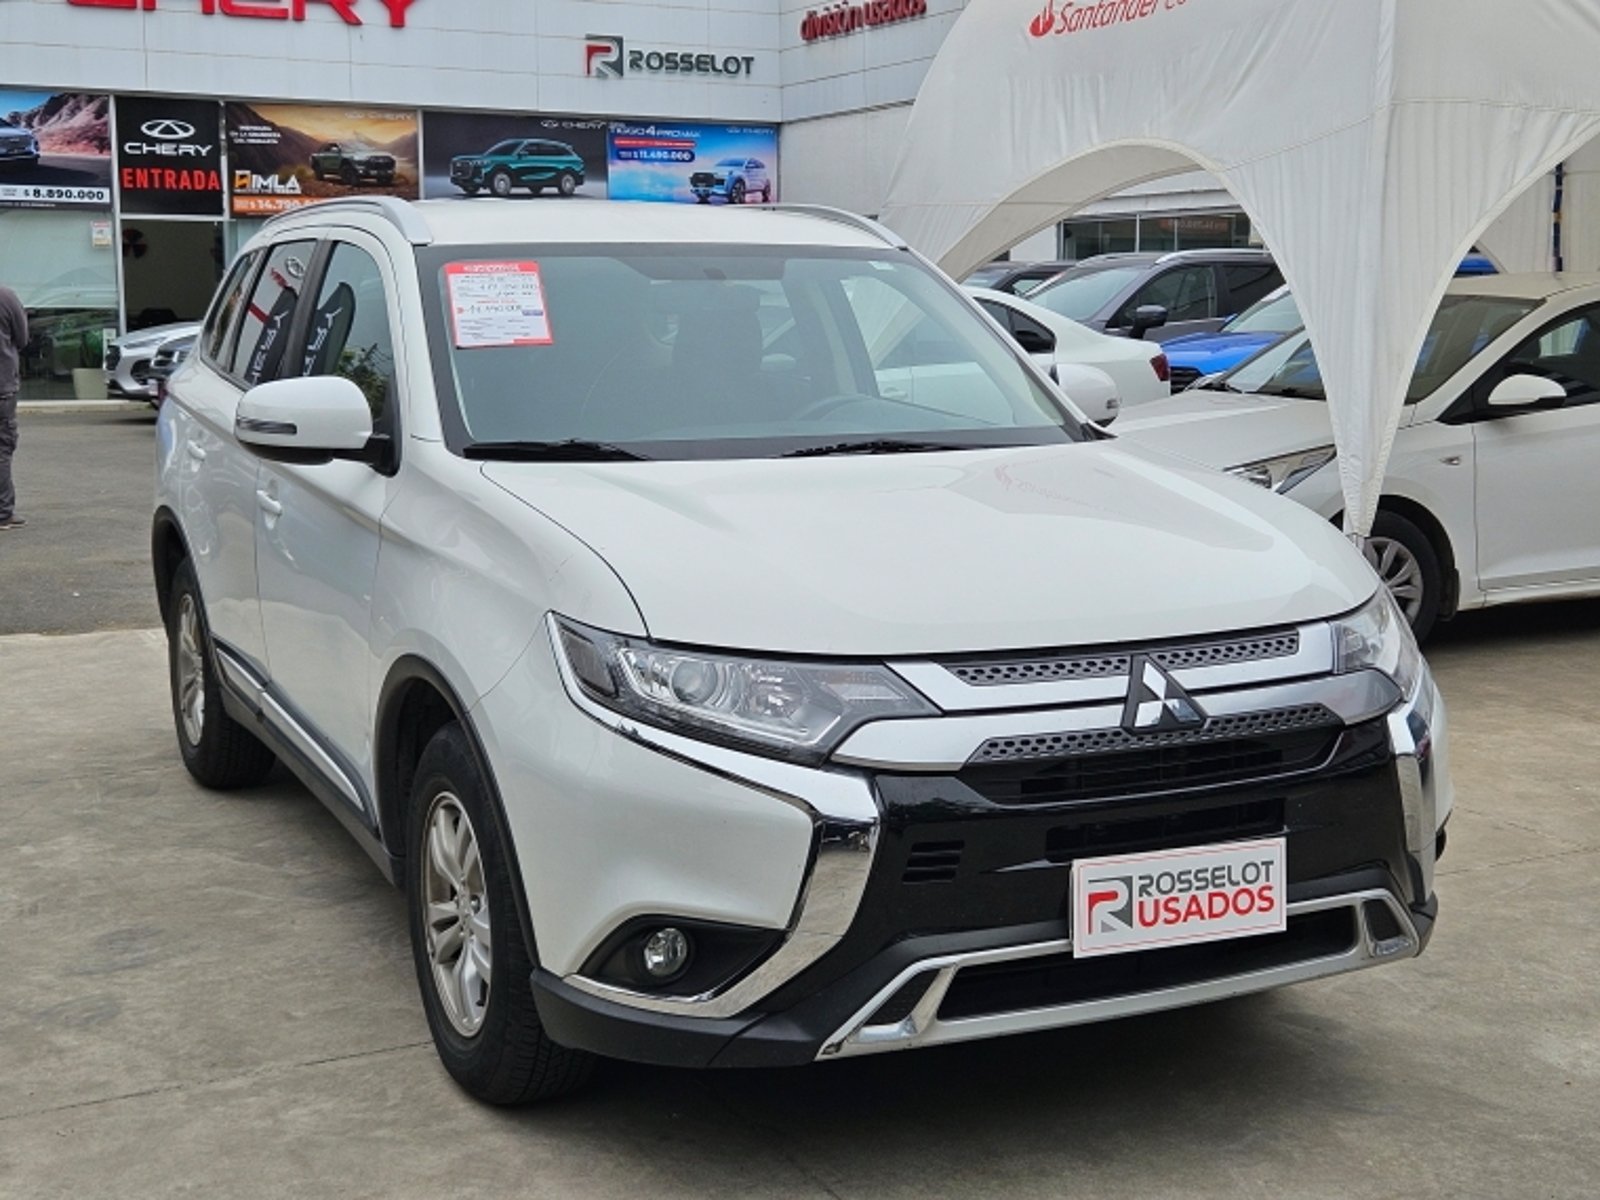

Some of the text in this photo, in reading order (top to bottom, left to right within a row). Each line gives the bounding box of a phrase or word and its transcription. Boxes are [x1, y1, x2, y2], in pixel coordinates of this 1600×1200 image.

[1054, 0, 1159, 34] Santander
[628, 49, 755, 76] ROSSELOT
[123, 142, 213, 157] CHERY
[122, 167, 221, 190] ENTRADA
[1138, 860, 1275, 897] ROSSELOT
[1138, 885, 1275, 928] USADOS
